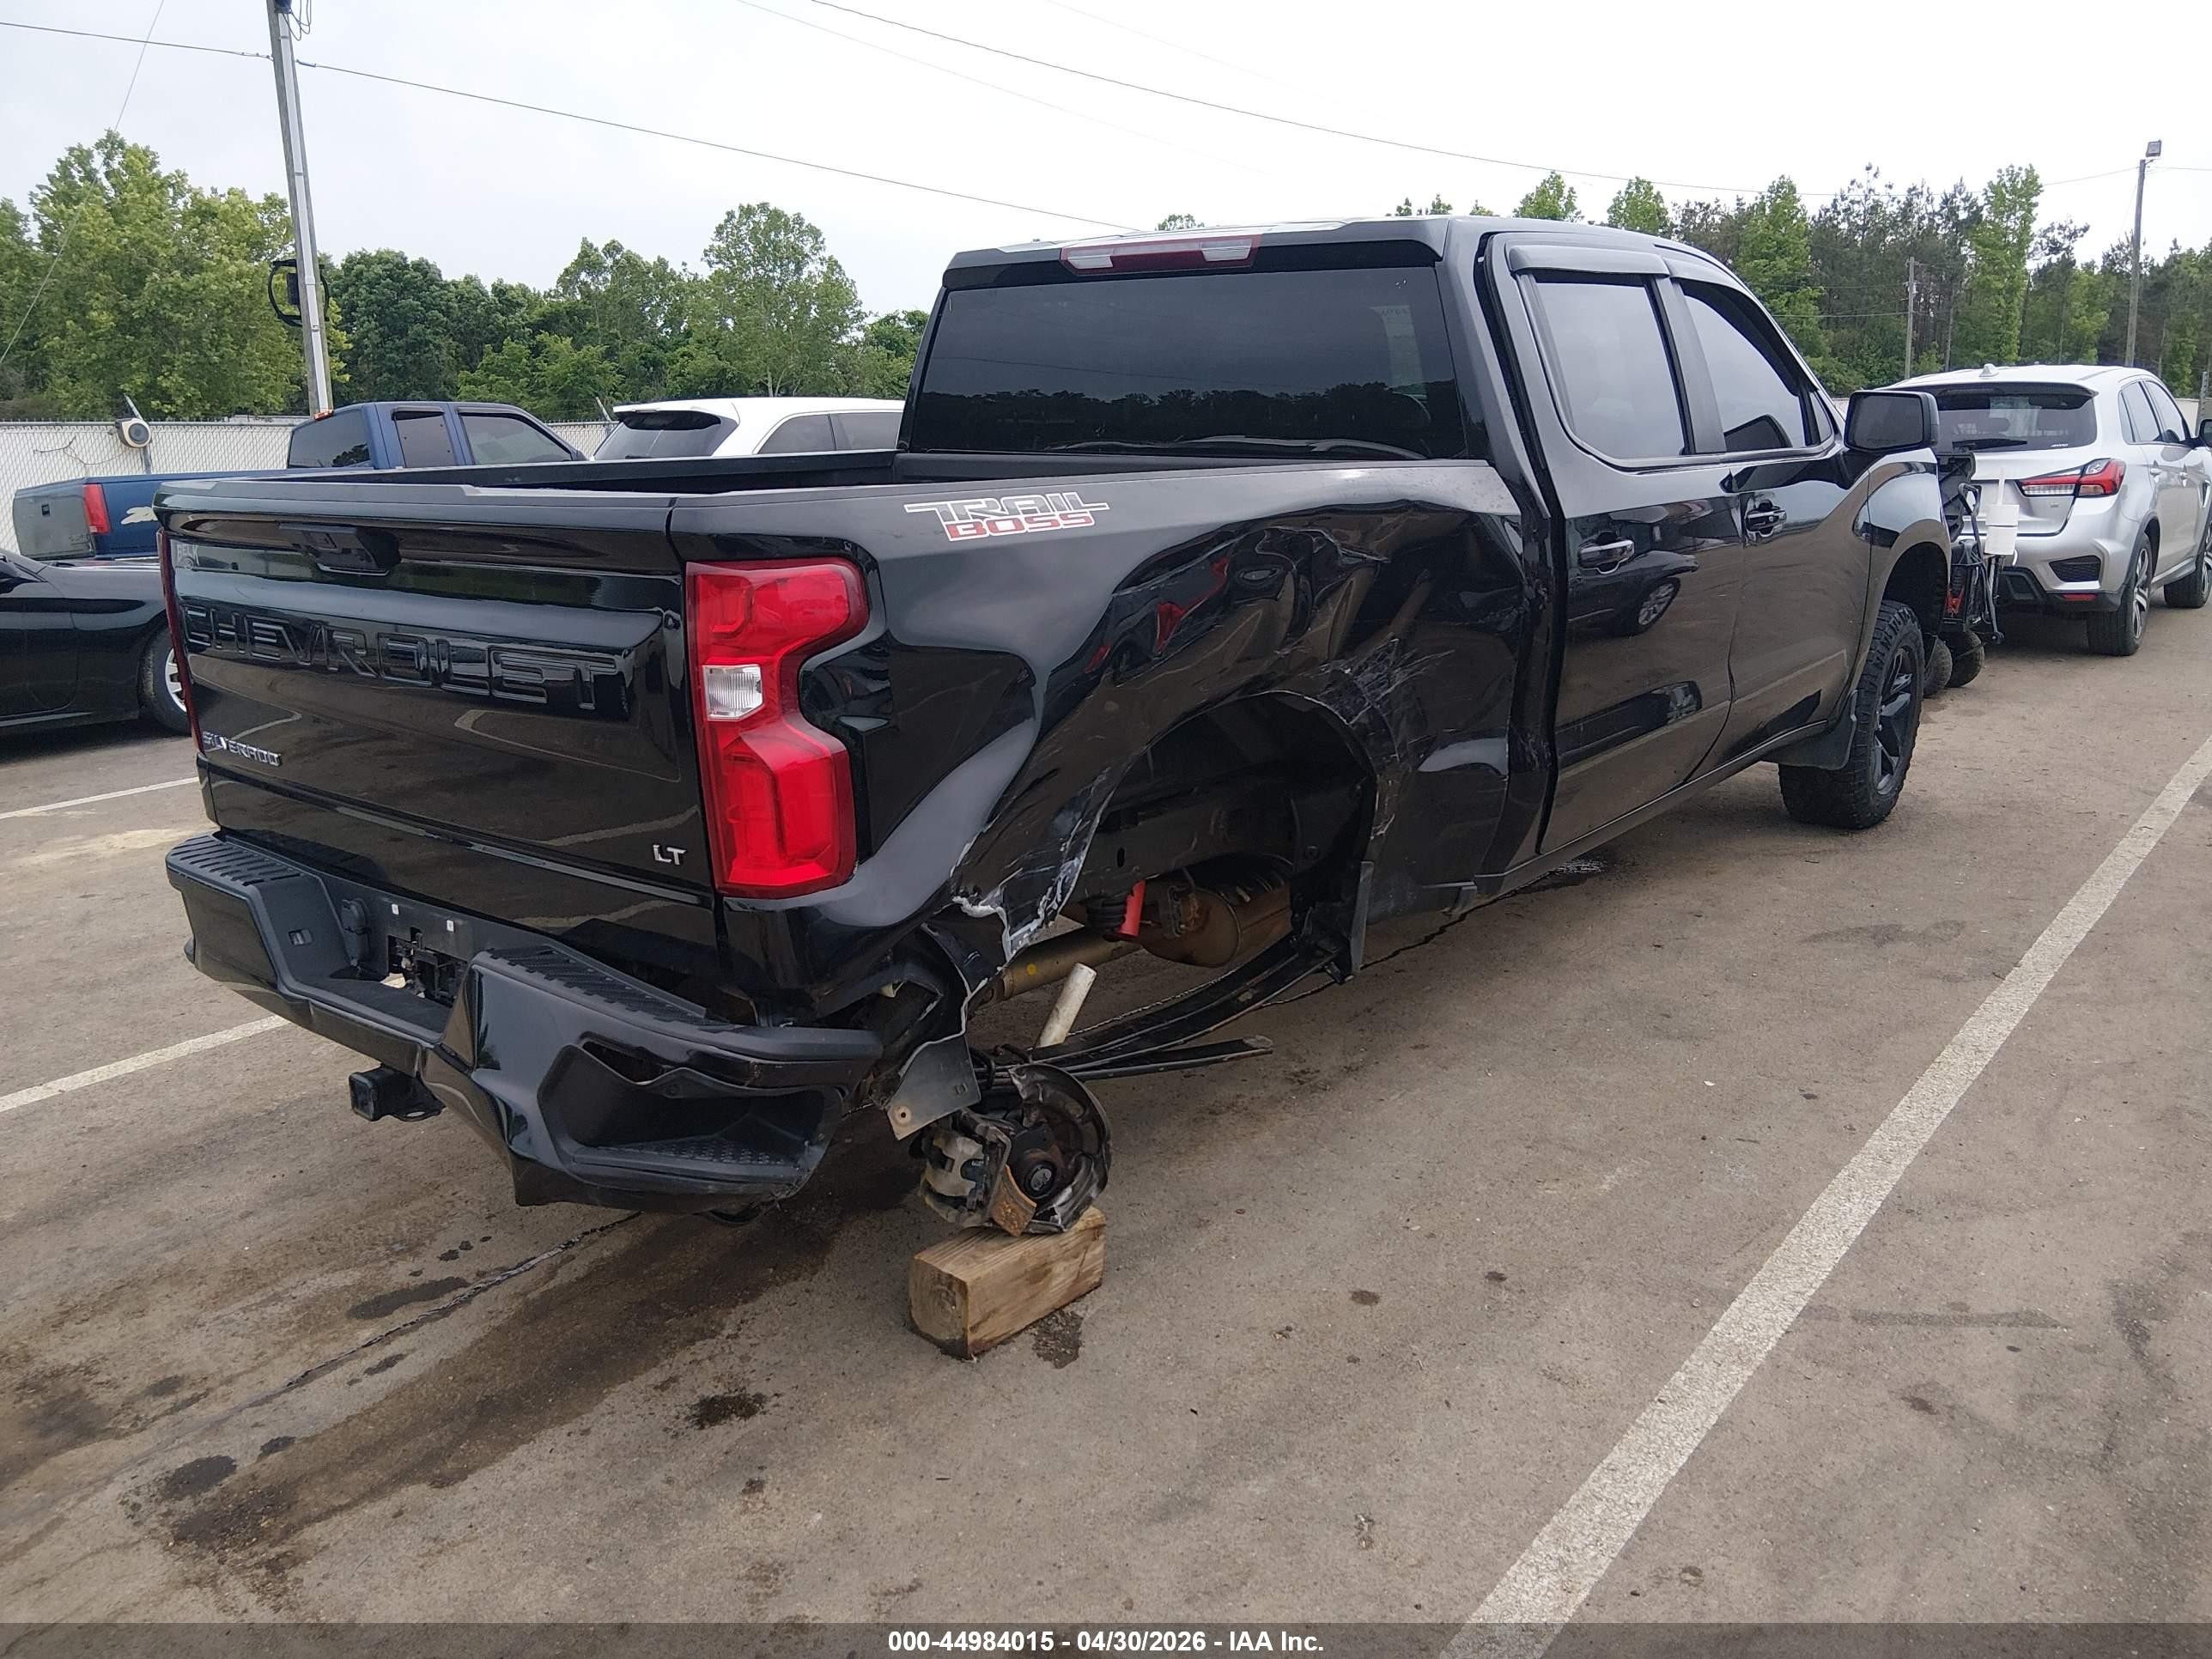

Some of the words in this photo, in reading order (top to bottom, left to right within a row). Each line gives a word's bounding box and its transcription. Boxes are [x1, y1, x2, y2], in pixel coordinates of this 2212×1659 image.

[904, 492, 1110, 524] TRAIL
[945, 512, 1095, 541] BOSS
[185, 605, 618, 710] CHEVROLET
[203, 731, 282, 767] SILVERADO
[653, 844, 687, 866] LT
